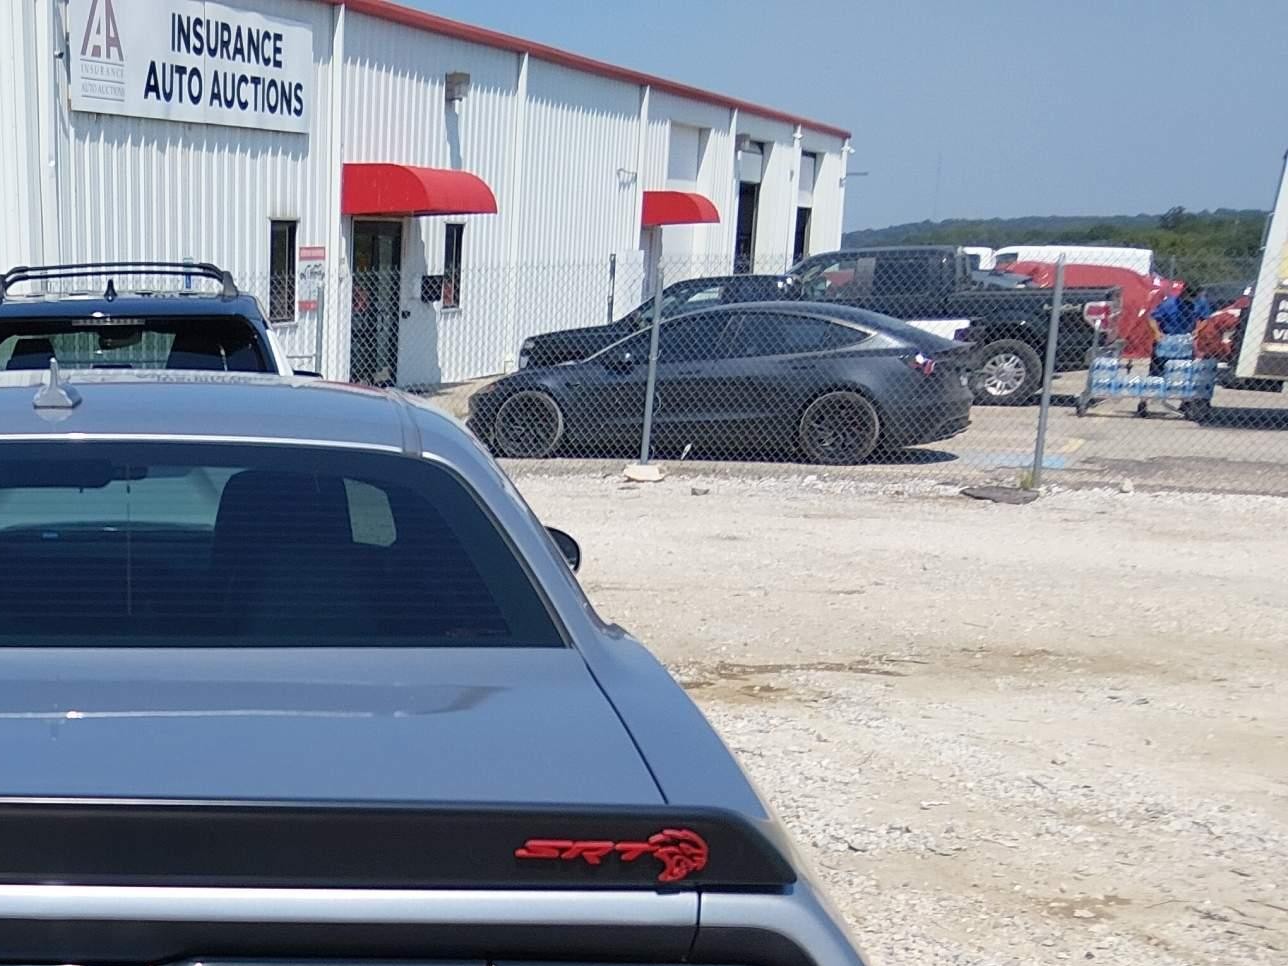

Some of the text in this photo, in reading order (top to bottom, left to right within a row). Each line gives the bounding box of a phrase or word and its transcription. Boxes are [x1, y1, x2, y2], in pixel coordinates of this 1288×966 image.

[171, 12, 283, 69] INSURANCE
[143, 60, 304, 117] AUTO AUCTIONS
